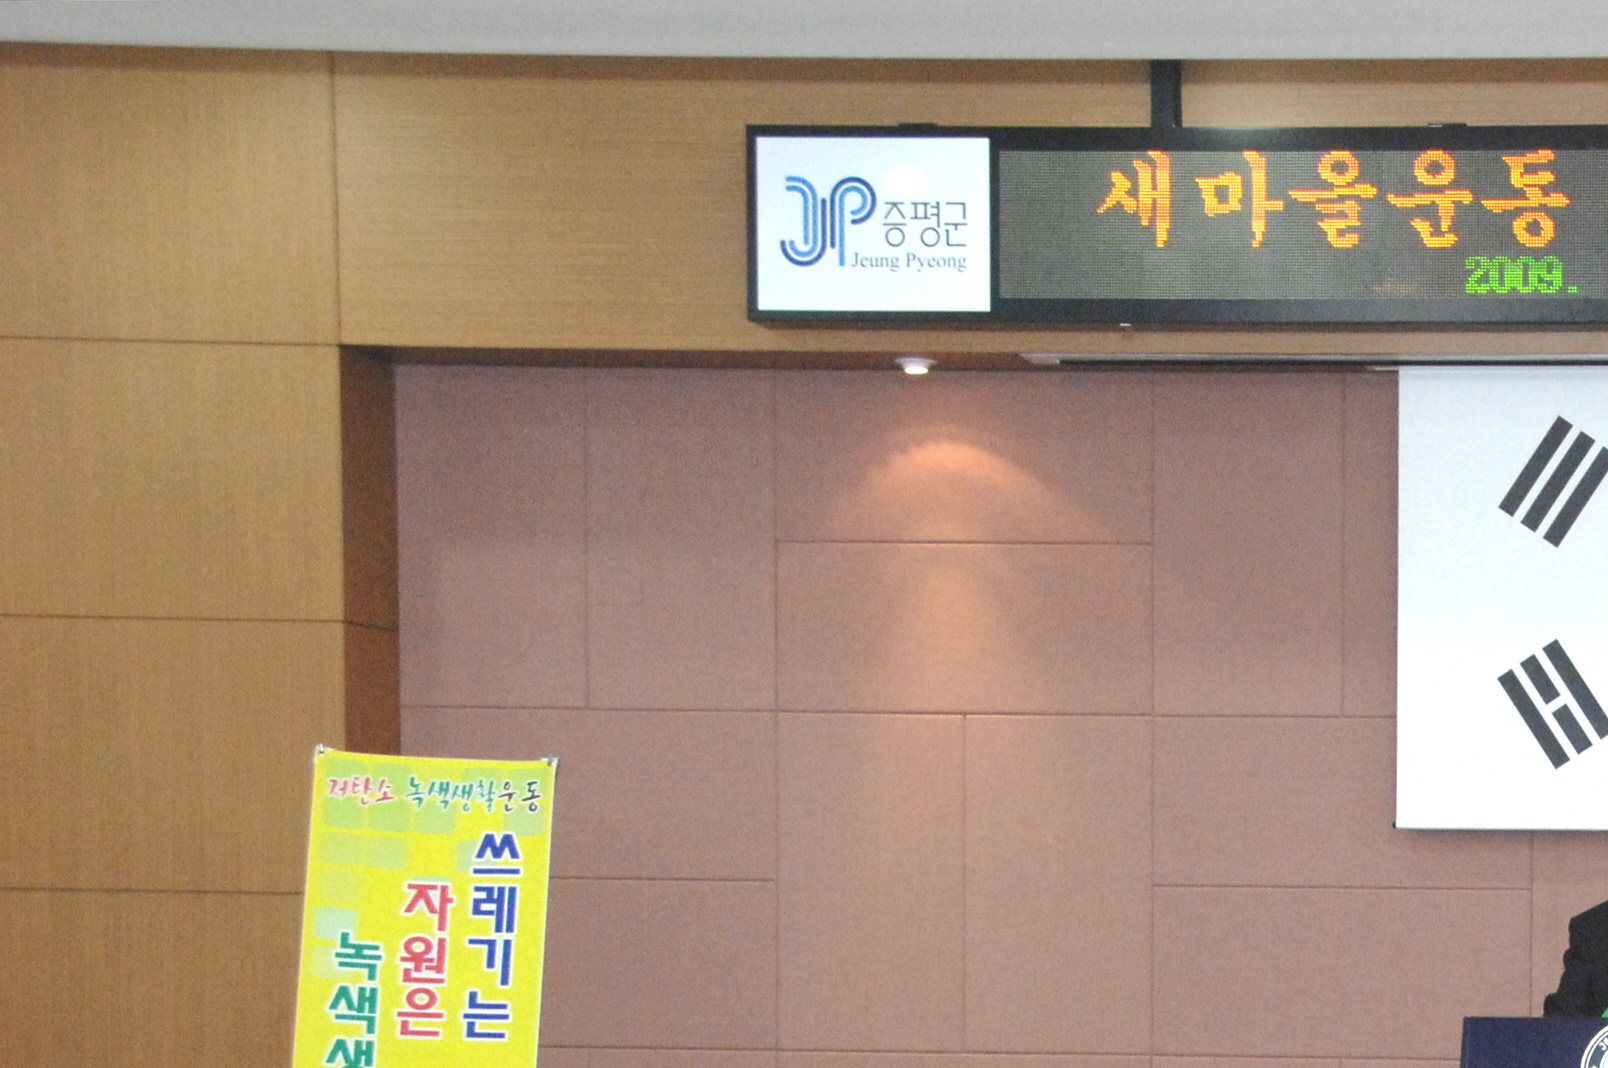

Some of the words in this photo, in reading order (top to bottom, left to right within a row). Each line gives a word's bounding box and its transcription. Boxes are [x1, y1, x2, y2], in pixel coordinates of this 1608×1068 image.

[1097, 149, 1570, 248] 새마을운동
[882, 200, 968, 248] 증평군
[851, 252, 900, 273] Jeung
[905, 252, 968, 273] Pyeong
[1465, 254, 1580, 295] 2009.
[328, 775, 396, 807] 저탄소
[405, 775, 542, 814] 녹색생활운동
[396, 881, 454, 1038] 자원은
[462, 831, 523, 1040] 쓰레기는
